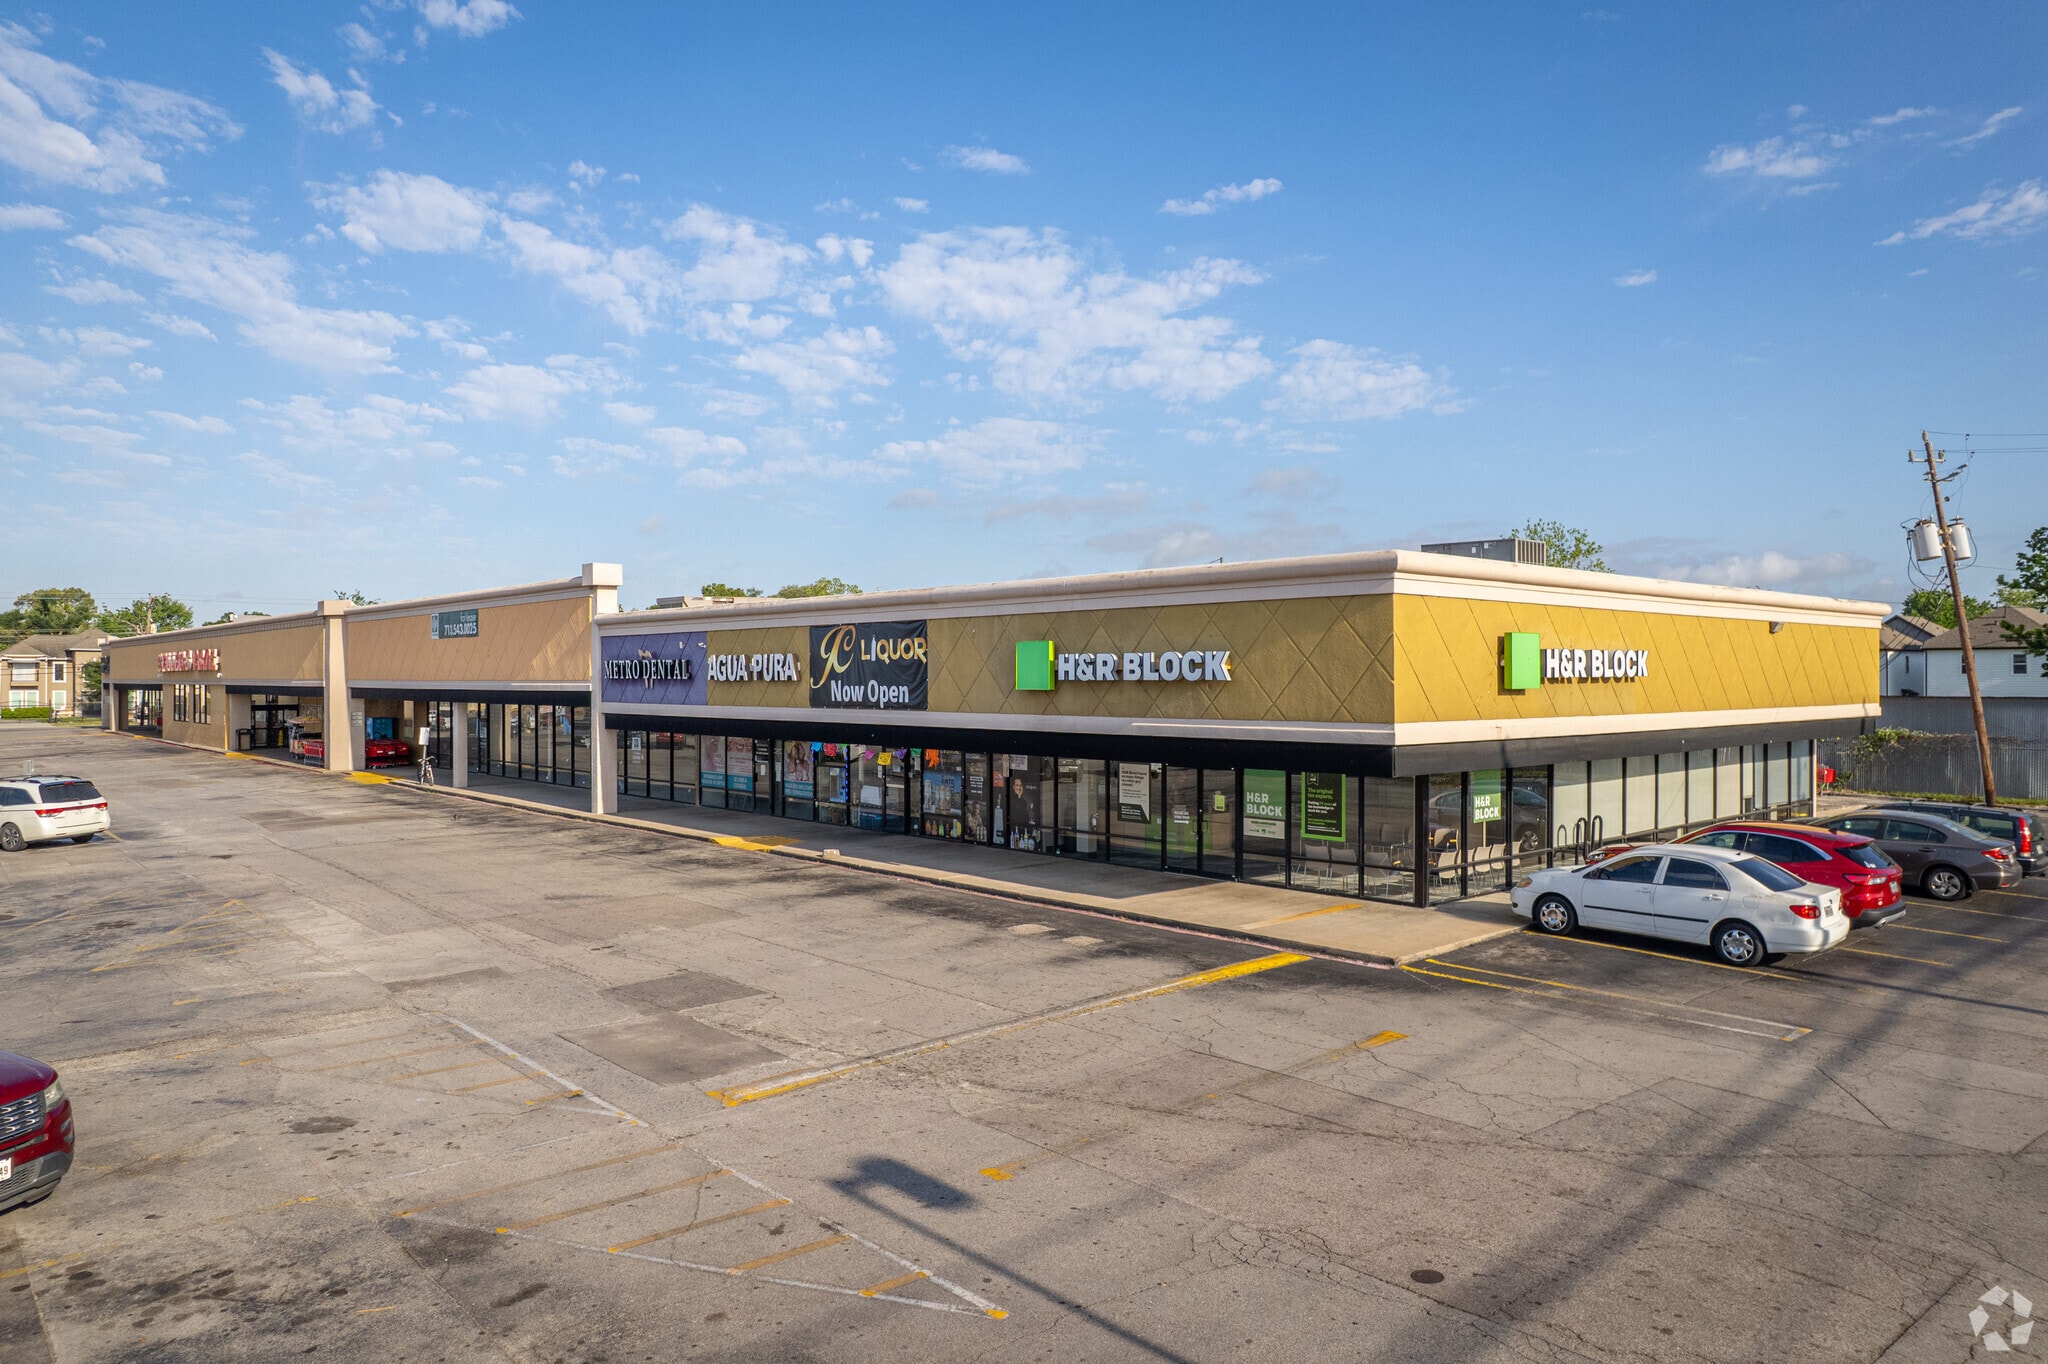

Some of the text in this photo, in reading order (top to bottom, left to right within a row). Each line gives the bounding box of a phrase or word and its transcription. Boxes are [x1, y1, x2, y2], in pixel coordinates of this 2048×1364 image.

[860, 635, 927, 665] LIQUOR
[604, 659, 689, 680] METRO DENTAL
[707, 653, 798, 681] AGUA PURA
[1057, 651, 1231, 682] H&R BLOCK
[1546, 648, 1648, 679] H&R BLOCK
[830, 680, 909, 709] Now Open
[1246, 791, 1269, 804] H&R
[1475, 796, 1490, 808] H&R
[1246, 803, 1283, 817] BLOCK
[1475, 806, 1499, 820] BLOCK
